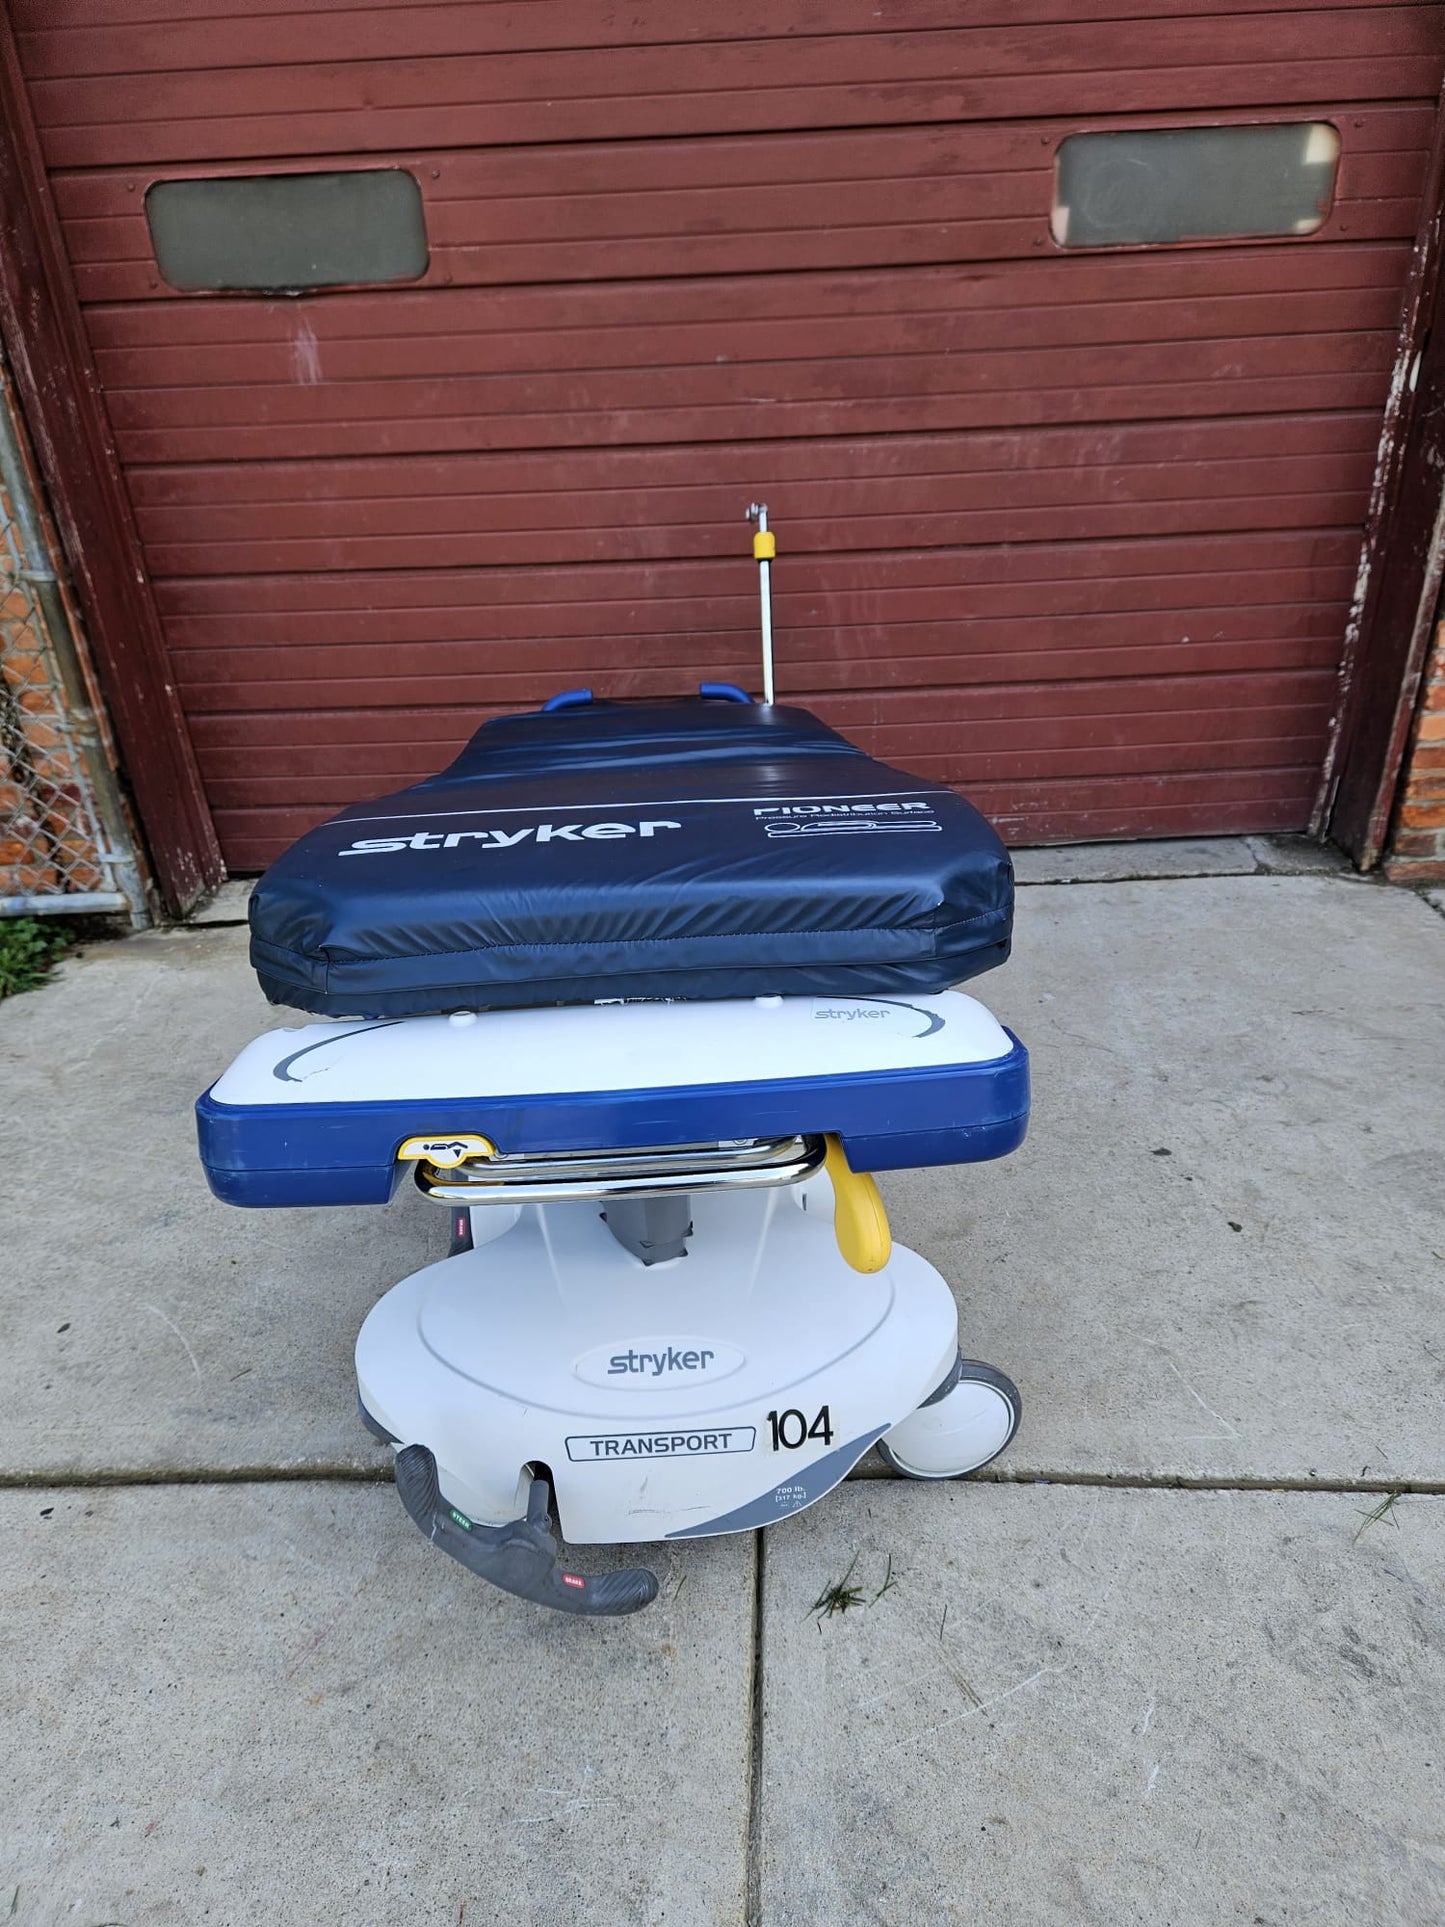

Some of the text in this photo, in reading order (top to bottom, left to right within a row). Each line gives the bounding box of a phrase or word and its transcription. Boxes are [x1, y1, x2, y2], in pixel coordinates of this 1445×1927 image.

[753, 802, 931, 816] PIONEER
[338, 821, 682, 856] stryker
[814, 1008, 890, 1020] stryker
[607, 1347, 715, 1376] stryker
[766, 1405, 834, 1452] 104
[590, 1432, 733, 1457] TRANSPORT
